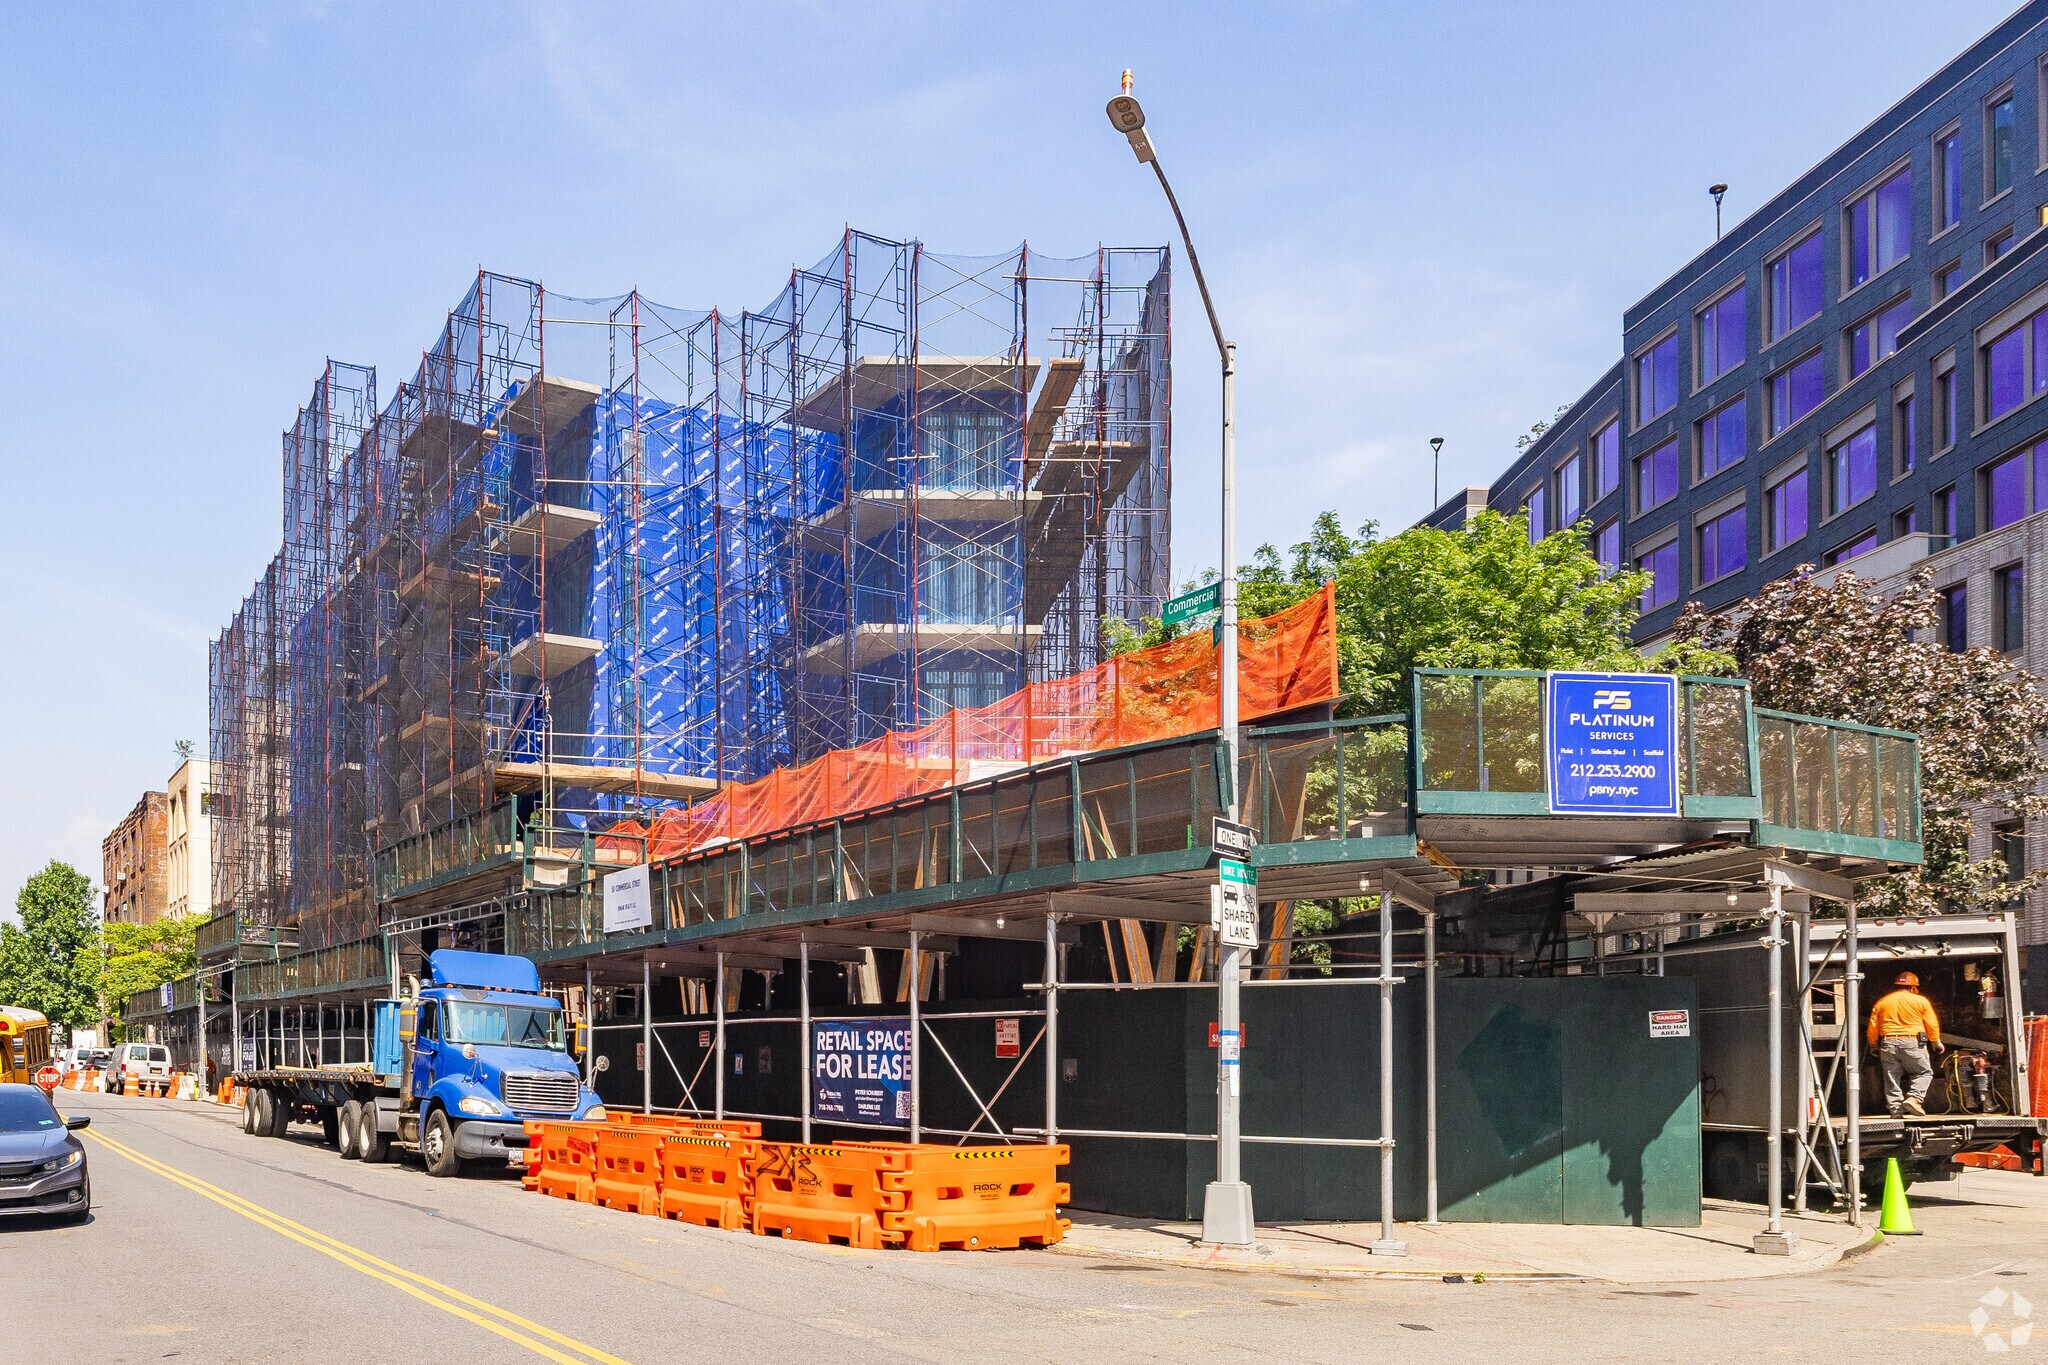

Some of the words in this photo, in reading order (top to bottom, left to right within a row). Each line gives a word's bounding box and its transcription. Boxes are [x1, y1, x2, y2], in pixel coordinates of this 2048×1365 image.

[1168, 586, 1217, 615] Commercial
[1186, 607, 1198, 616] Street
[1570, 713, 1654, 727] PLATINUM
[1589, 732, 1635, 741] SERVICES
[1570, 763, 1656, 778] 212.253.2900
[1589, 785, 1639, 798] psny.nyc
[1221, 830, 1236, 846] ONE
[1223, 866, 1235, 877] BIKE
[1237, 868, 1254, 880] ROUTE
[1224, 908, 1255, 924] SHARED
[1229, 925, 1250, 940] LANE
[817, 1031, 863, 1051] RETAIL
[866, 1030, 911, 1051] SPACE
[816, 1054, 852, 1078] FOR
[858, 1054, 911, 1080] LEASE
[40, 1073, 59, 1083] STOP
[799, 1179, 822, 1187] ROCK
